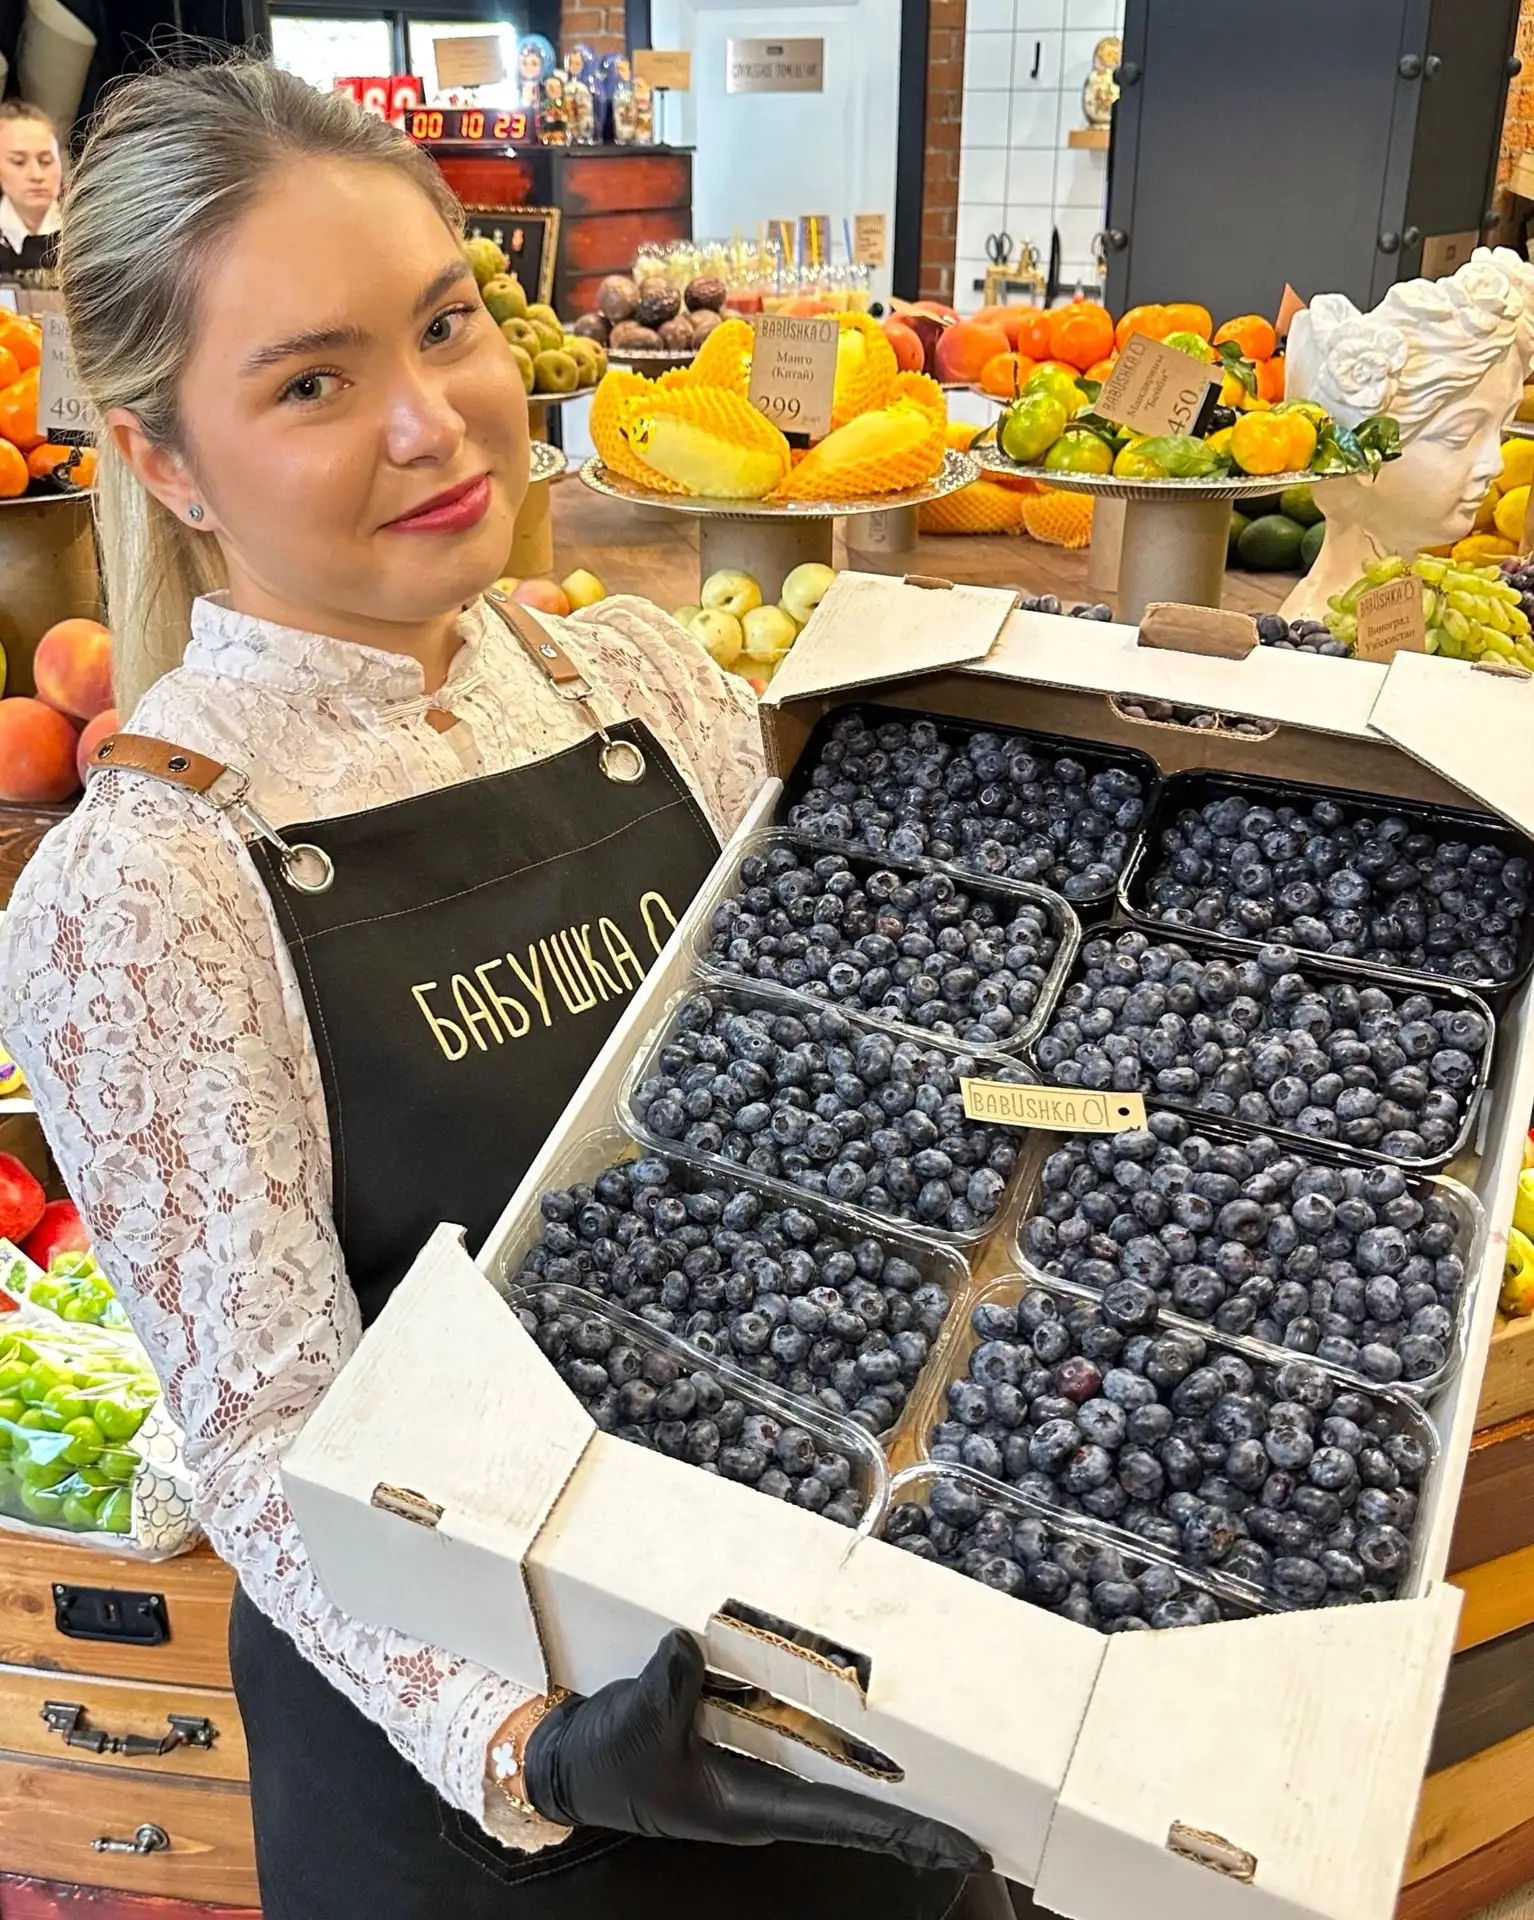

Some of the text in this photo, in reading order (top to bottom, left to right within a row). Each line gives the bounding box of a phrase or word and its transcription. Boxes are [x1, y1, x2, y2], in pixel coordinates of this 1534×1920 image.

[412, 111, 527, 139] 00 10 23
[761, 320, 818, 341] BABUSHKA
[776, 351, 813, 365] Манго
[771, 366, 815, 382] (Китай)
[1102, 355, 1139, 412] BABUSHKA
[758, 394, 802, 420] 299
[1167, 388, 1200, 435] 450
[1360, 587, 1403, 619] BABUSHKA
[1367, 615, 1411, 637] Виноград
[1364, 629, 1416, 653] Узбекистан
[411, 916, 647, 1062] БАБУШКА
[972, 1091, 1078, 1124] BABUSHKA
